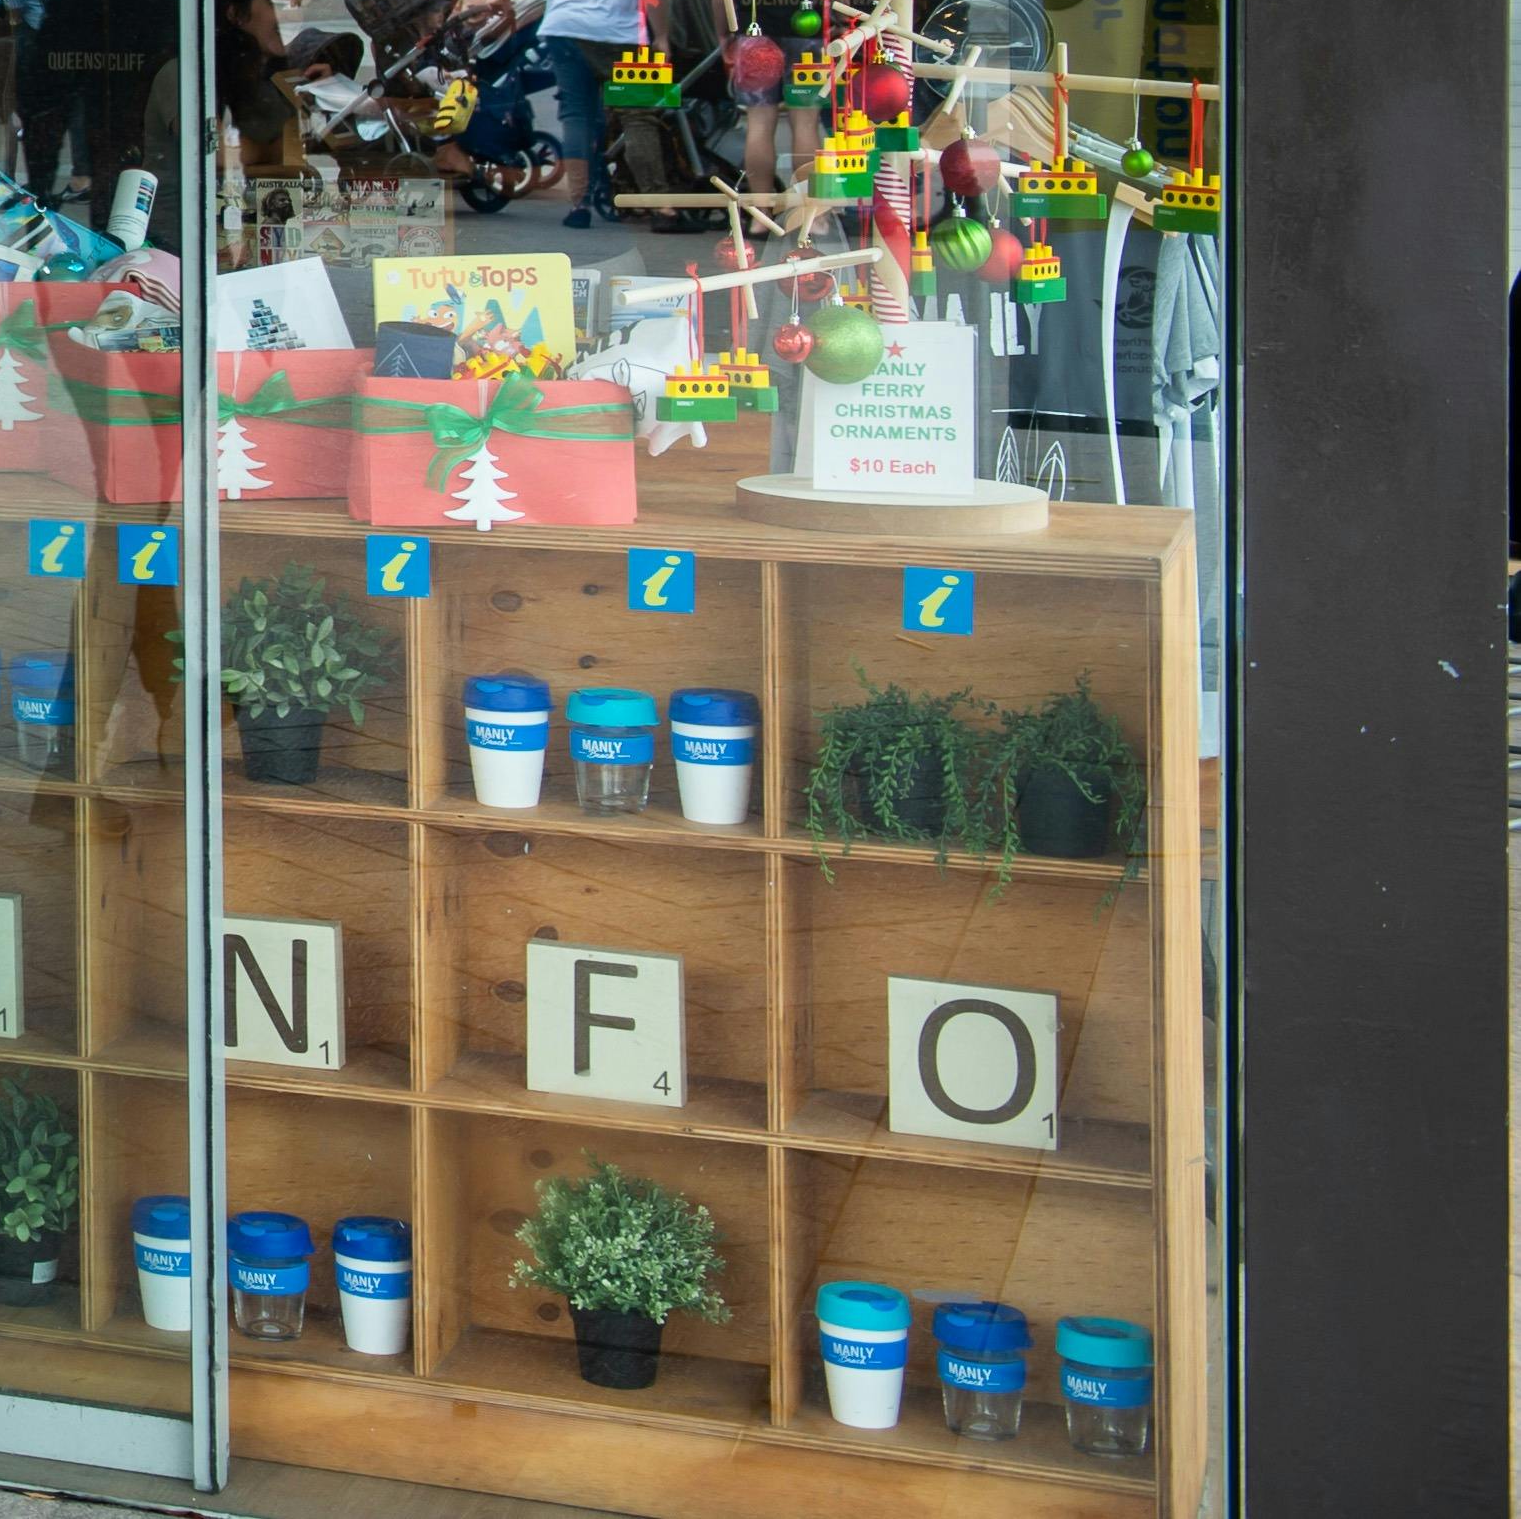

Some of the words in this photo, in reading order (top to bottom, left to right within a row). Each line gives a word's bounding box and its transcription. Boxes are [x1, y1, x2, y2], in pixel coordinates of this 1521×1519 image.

[407, 266, 466, 290] Tutu
[477, 265, 538, 292] Tops
[872, 362, 926, 377] ANLY
[861, 382, 926, 398] FERRY
[834, 403, 952, 420] CHRISTMAS
[829, 424, 957, 442] ORNAMENTS
[849, 457, 884, 474] $10
[889, 459, 936, 475] Each
[18, 699, 52, 714] MANLY
[475, 725, 515, 741] MANLY
[582, 738, 623, 754] MANLY
[684, 740, 727, 755] MANLY
[572, 958, 638, 1078] F
[917, 998, 1038, 1126] O
[652, 1070, 672, 1097] 4
[143, 1250, 183, 1267] MANLY
[238, 1269, 276, 1285] MANLY
[344, 1272, 381, 1289] MANLY
[831, 1342, 875, 1359] MANLY
[948, 1361, 992, 1381] MANLY
[1066, 1374, 1107, 1395] MANLY
